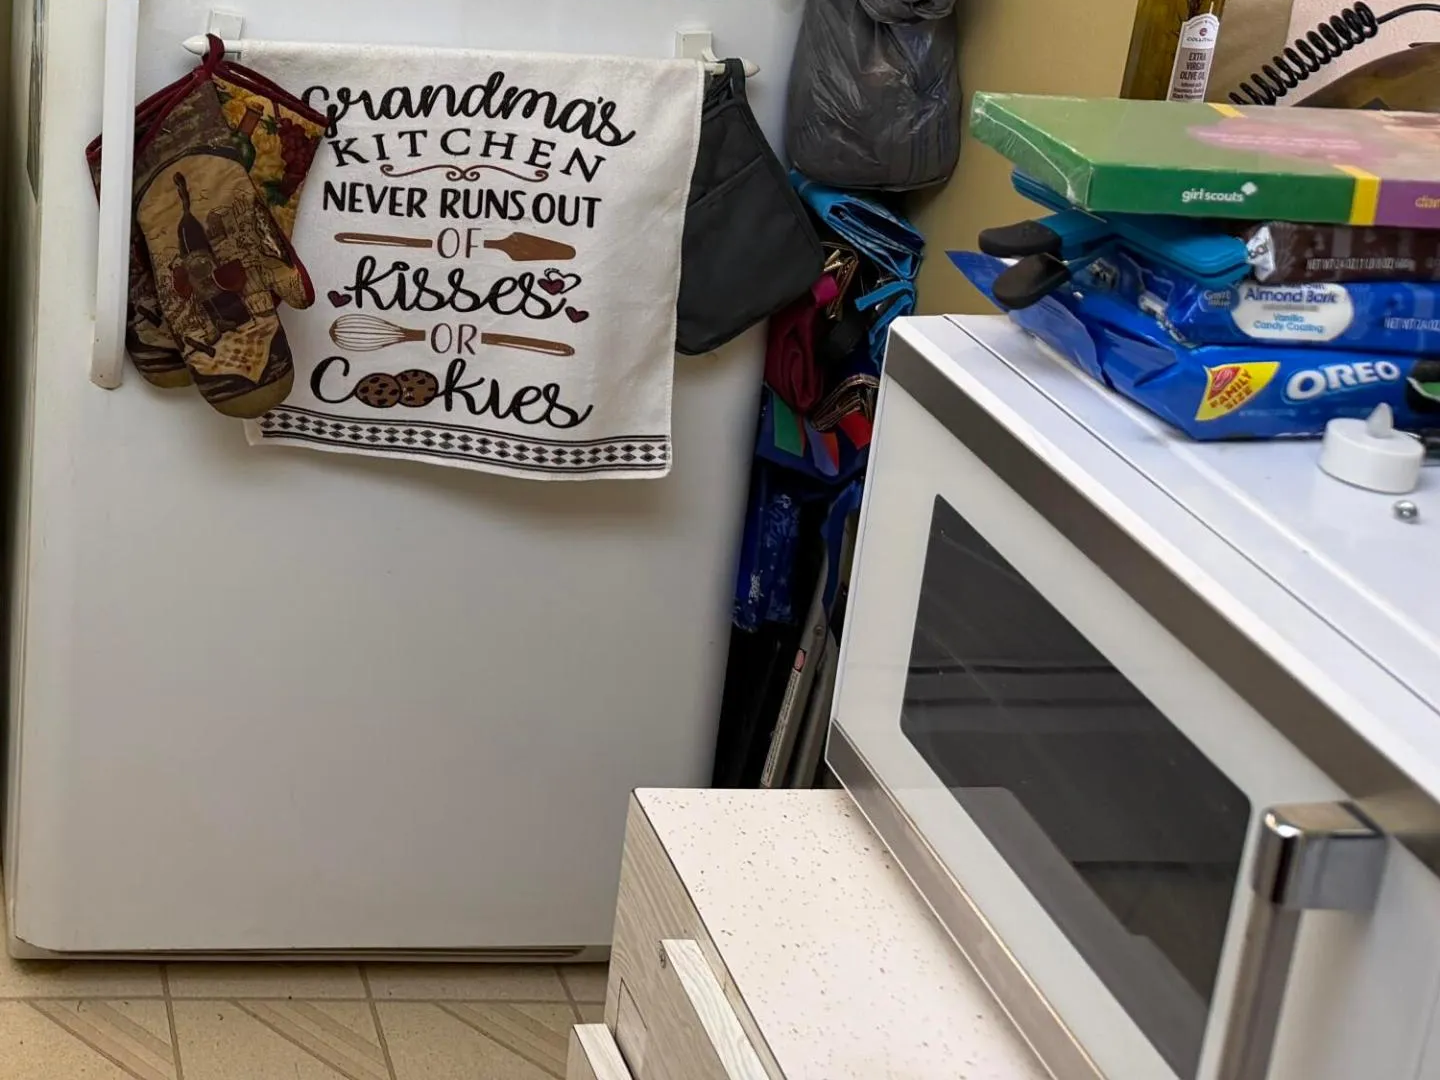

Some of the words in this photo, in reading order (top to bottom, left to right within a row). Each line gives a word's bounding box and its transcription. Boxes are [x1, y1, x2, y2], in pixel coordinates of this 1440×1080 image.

[1180, 71, 1198, 81] OLIVE
[302, 71, 636, 147] Grandma's
[327, 127, 606, 184] KITCHEN
[322, 180, 427, 219] NEVER
[440, 188, 526, 220] RUNS
[531, 191, 603, 229] OUT
[436, 227, 483, 260] OF
[1244, 287, 1303, 303] Almond
[1305, 290, 1339, 303] Bark
[1253, 320, 1284, 332] Candy
[1286, 322, 1325, 334] Coating
[1273, 312, 1305, 322] Vanilla
[430, 323, 479, 355] OR
[1209, 368, 1252, 409] FAMILY
[1285, 361, 1402, 401] OREO
[1224, 385, 1253, 410] SIZE
